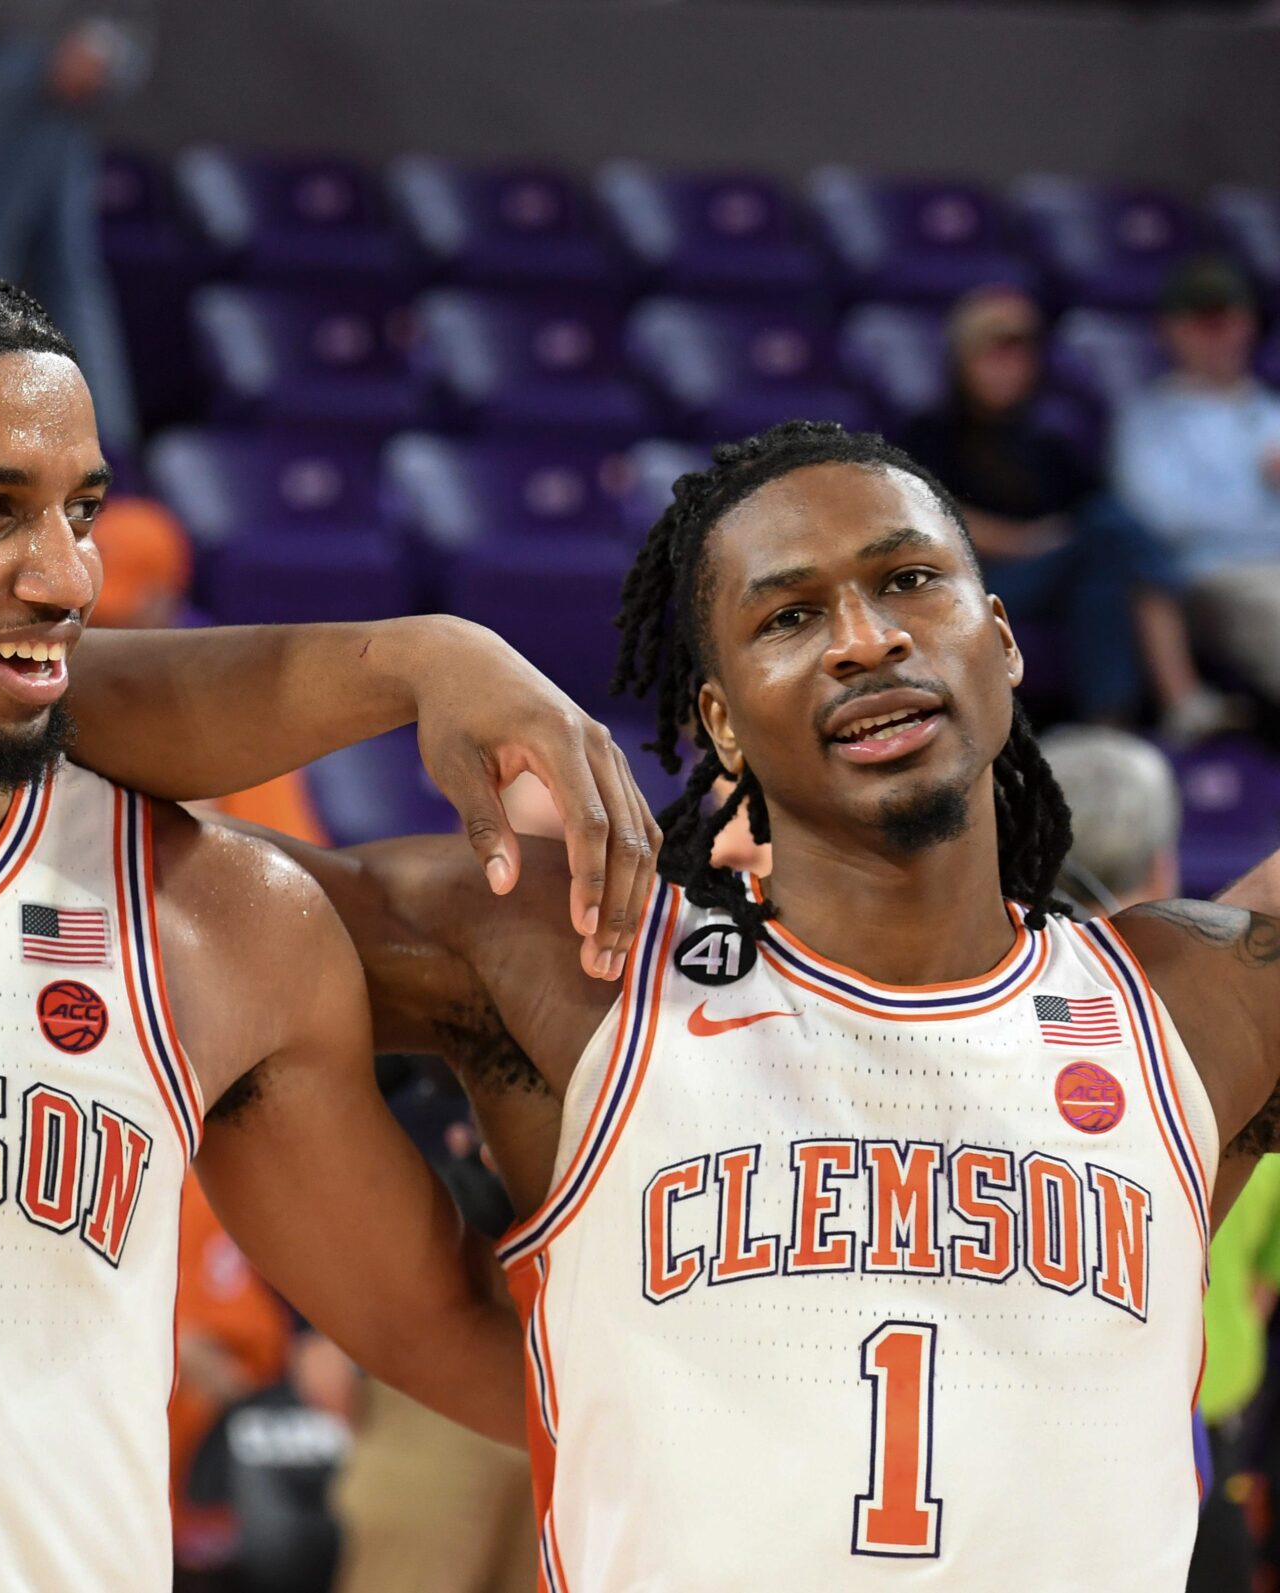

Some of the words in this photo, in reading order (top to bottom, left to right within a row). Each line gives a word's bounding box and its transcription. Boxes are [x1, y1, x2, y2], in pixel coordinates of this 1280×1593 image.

[680, 931, 741, 975] 41
[48, 1003, 101, 1021] ACC
[1066, 1084, 1116, 1100] ACC
[641, 1137, 1153, 1322] CLEMSON
[851, 1320, 942, 1557] 1
